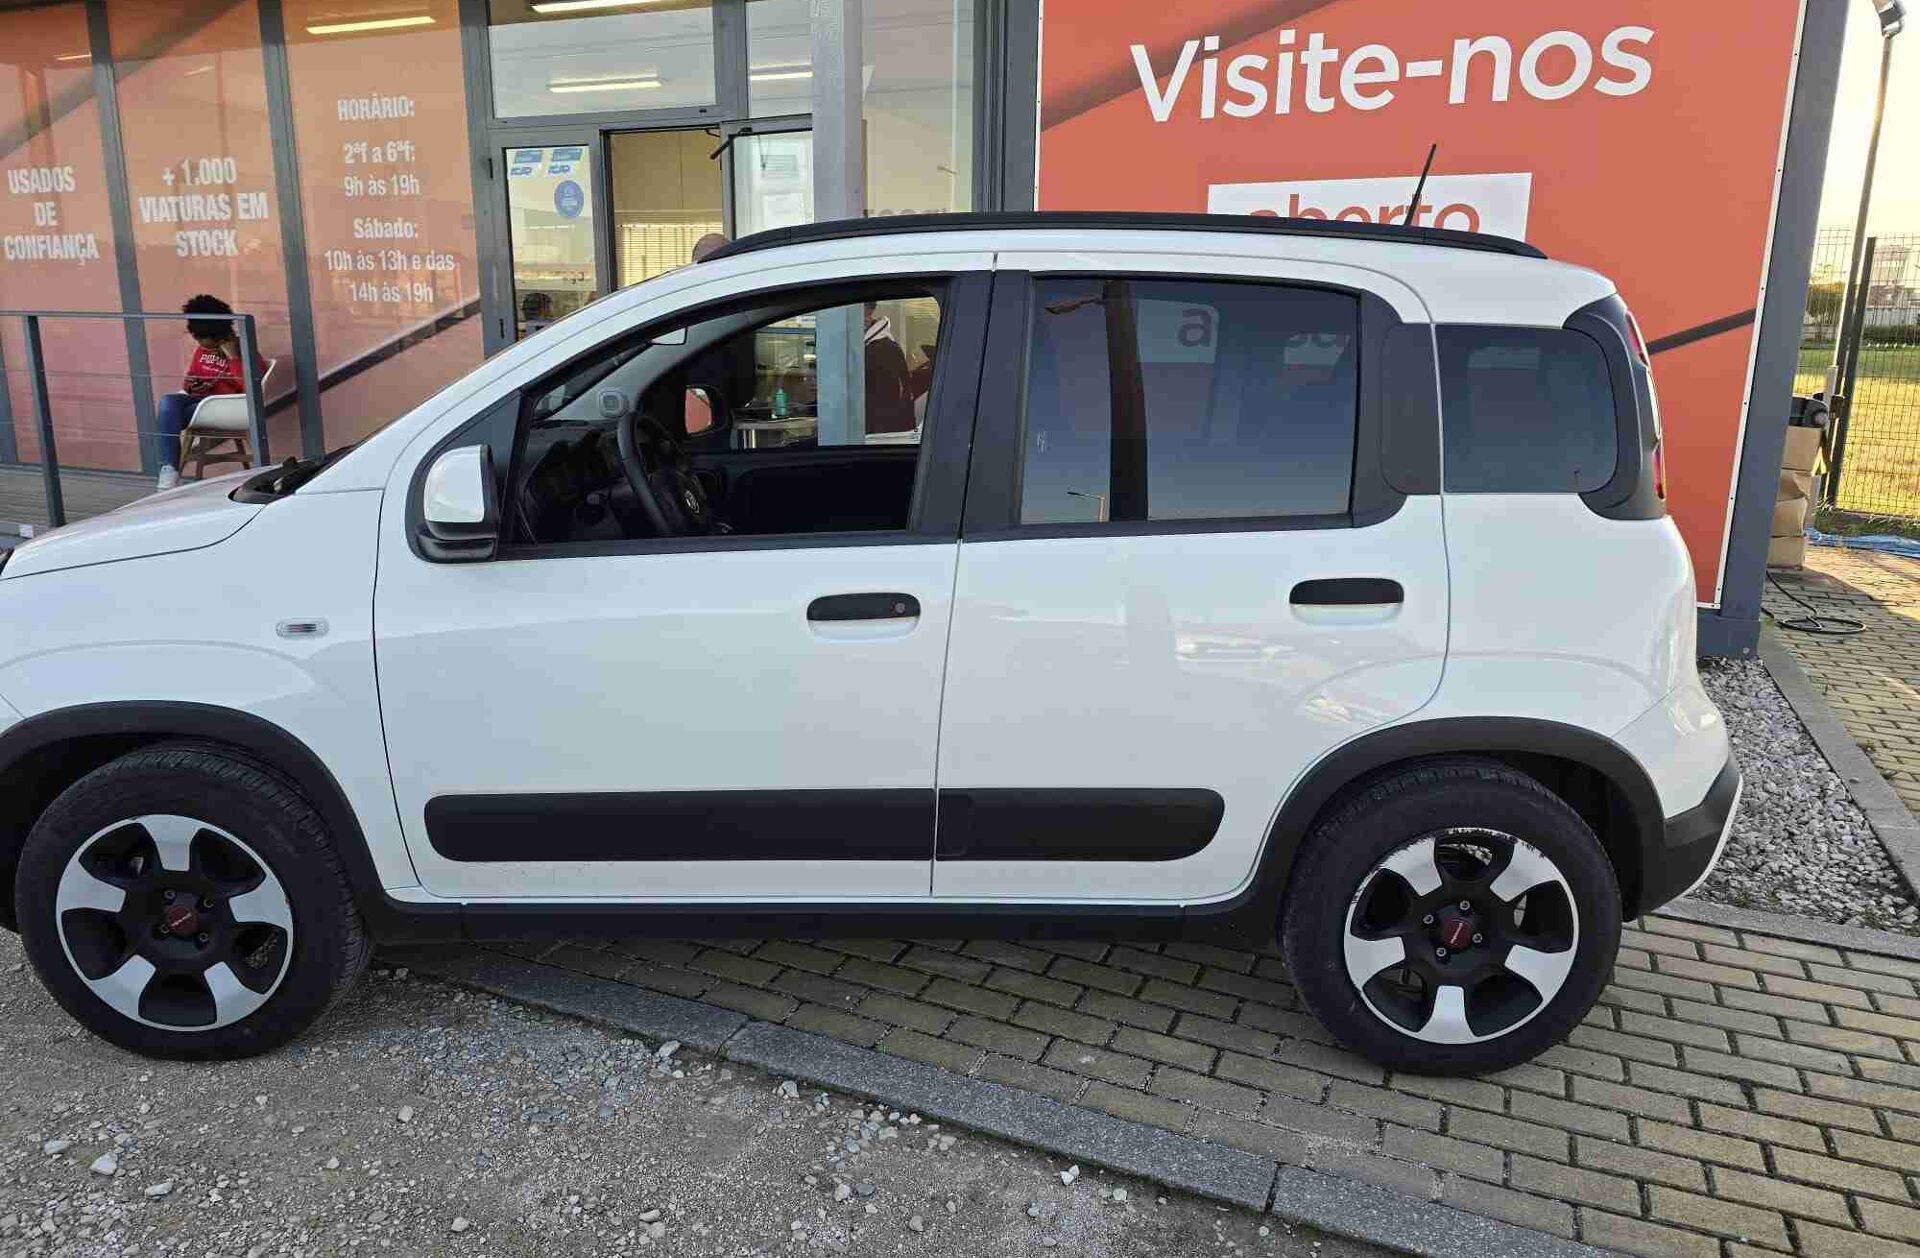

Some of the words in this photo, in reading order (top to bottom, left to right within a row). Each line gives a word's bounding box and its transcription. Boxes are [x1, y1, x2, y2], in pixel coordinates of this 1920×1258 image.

[1130, 26, 1655, 122] Visite-nos
[337, 92, 415, 121] HORÁRIO:
[371, 146, 383, 163] a
[7, 165, 76, 193] USADOS
[181, 156, 237, 186] 1.000
[344, 175, 365, 197] 9h
[391, 173, 420, 196] 19h
[33, 201, 58, 227] DE
[138, 194, 231, 223] VIATURAS
[236, 191, 268, 220] EM
[353, 216, 418, 239] Sábado:
[4, 232, 100, 268] CONFIANÇA
[176, 230, 239, 257] STOCK
[324, 249, 353, 271] 10h
[379, 248, 407, 271] 13h
[411, 253, 422, 270] e
[425, 249, 456, 271] das
[350, 280, 378, 302] 14h
[405, 281, 434, 303] 19h
